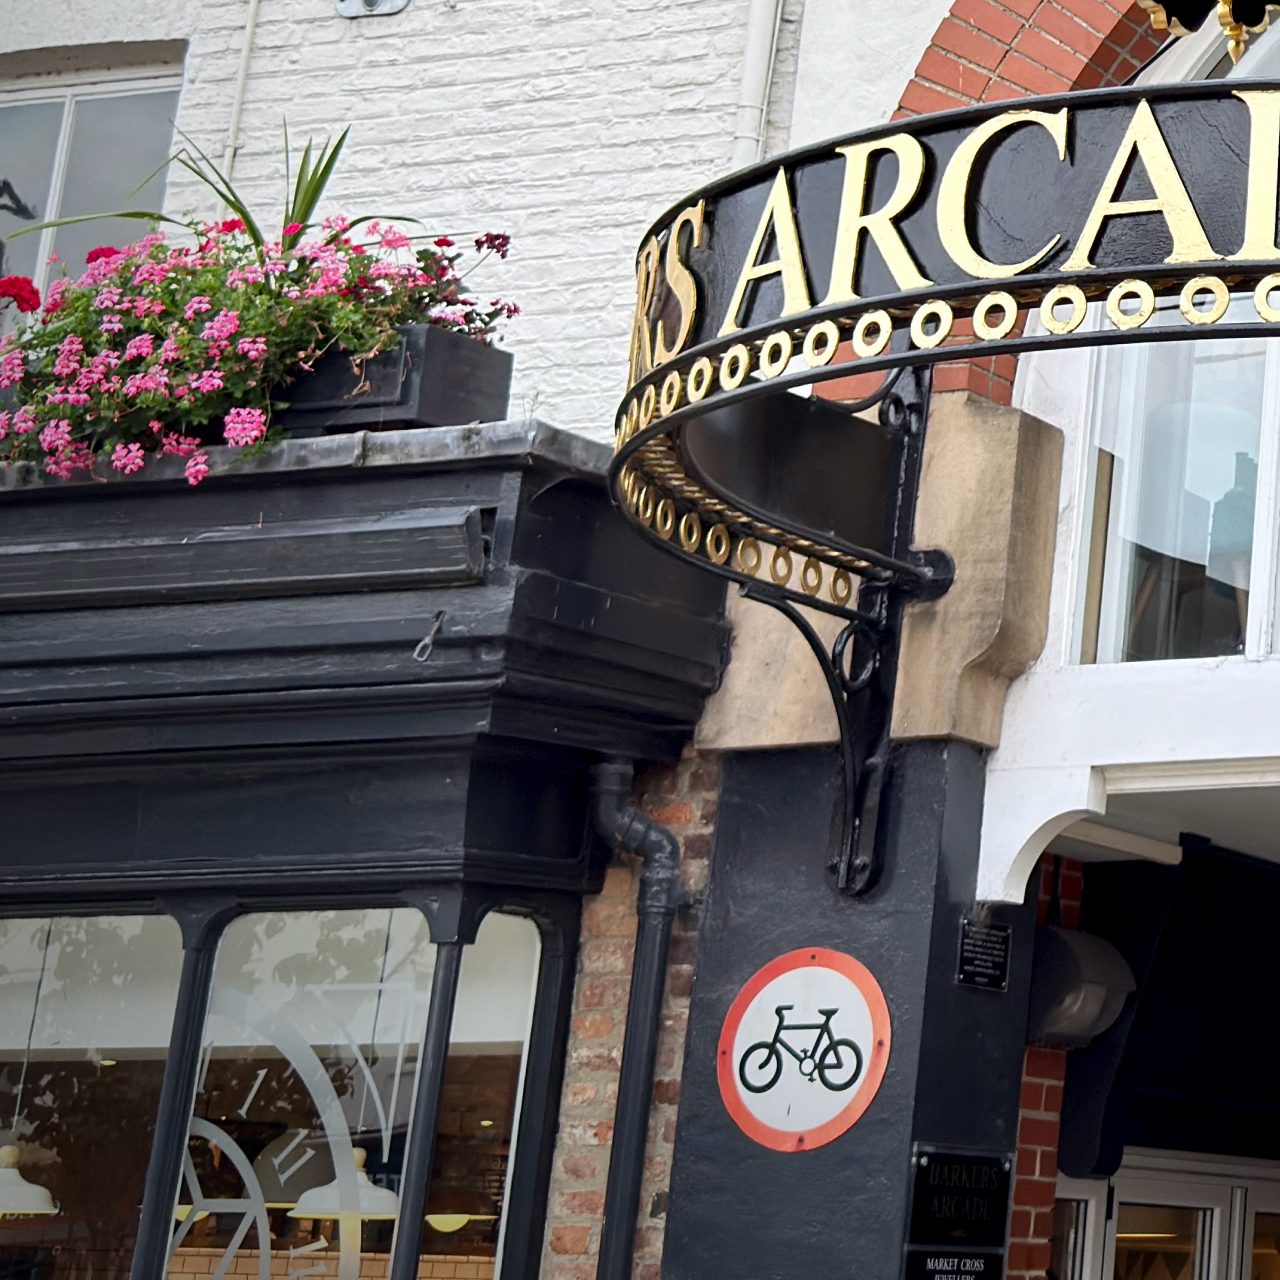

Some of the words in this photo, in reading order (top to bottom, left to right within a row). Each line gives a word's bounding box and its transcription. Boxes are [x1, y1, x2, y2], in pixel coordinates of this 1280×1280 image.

[929, 1161, 999, 1190] BARKERS
[928, 1194, 992, 1221] ARCADE
[926, 1257, 959, 1271] MARKET
[960, 1258, 985, 1273] CROSS
